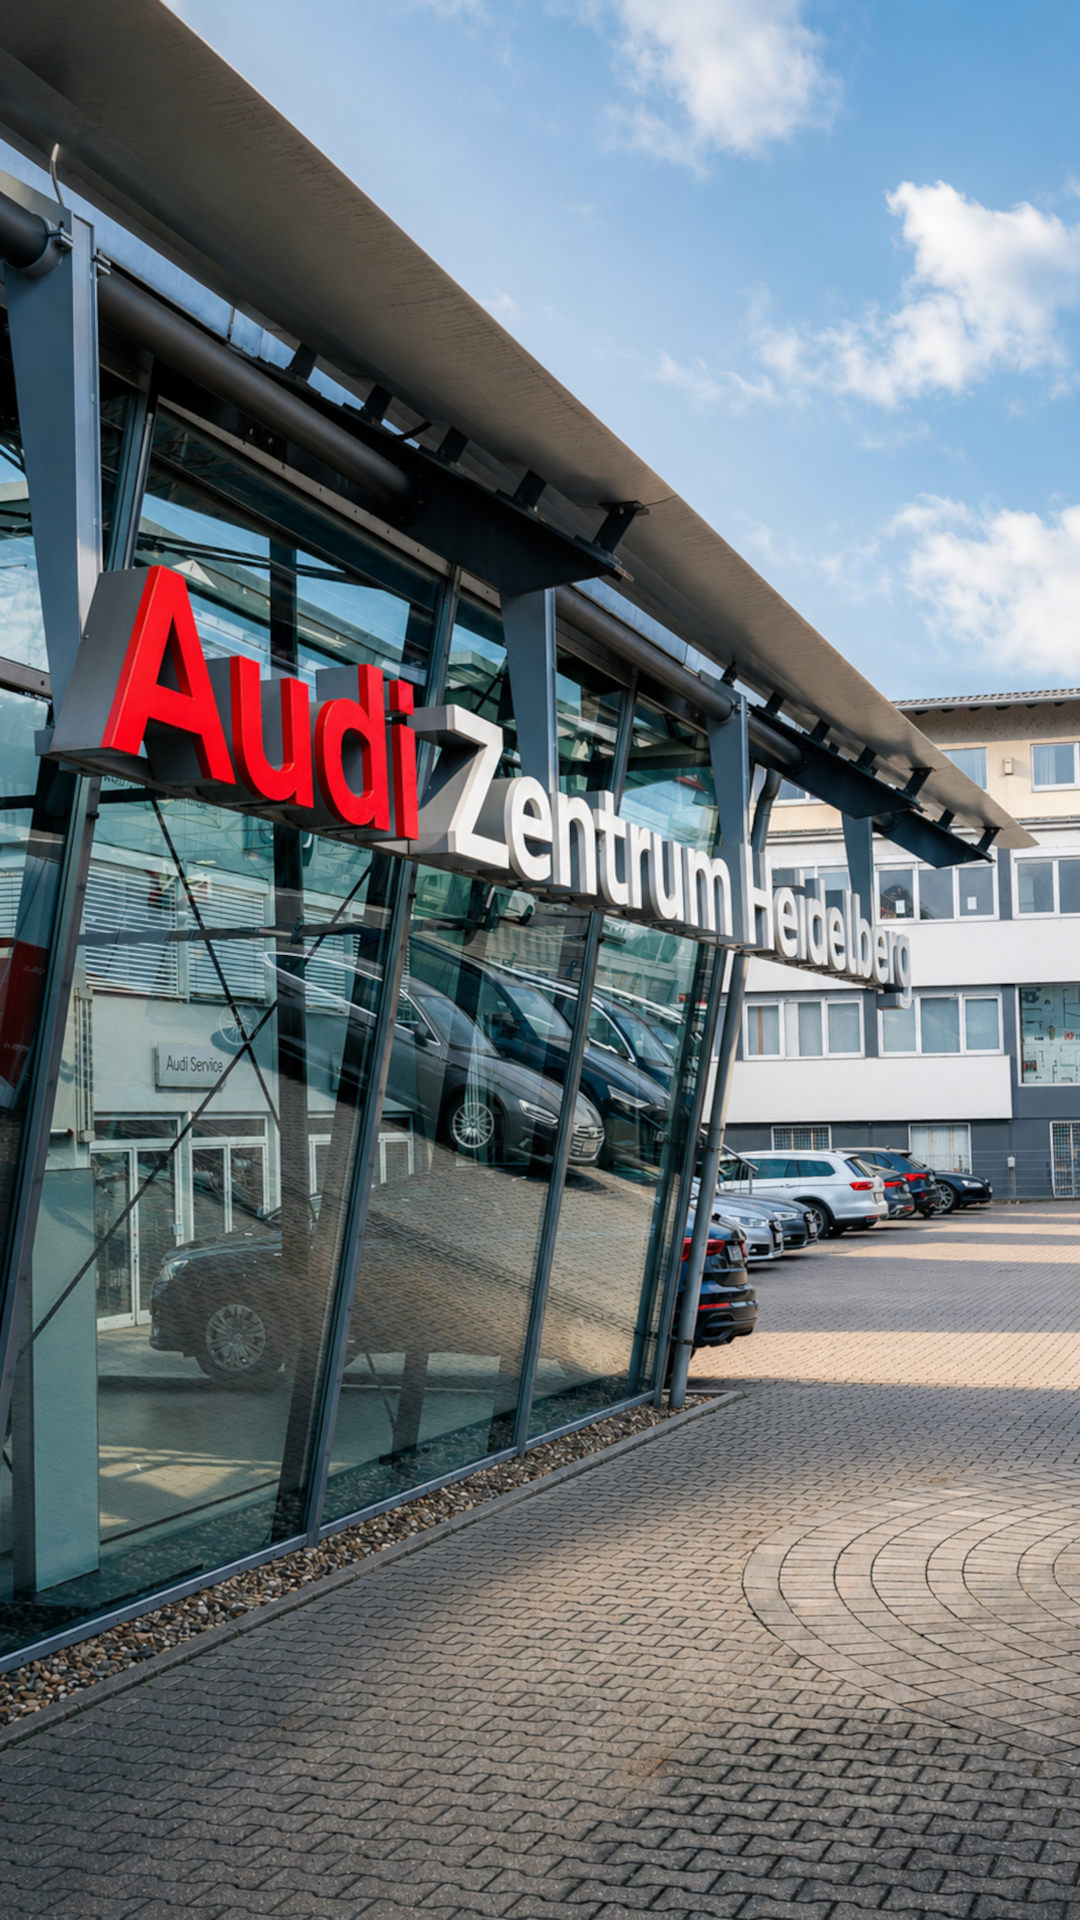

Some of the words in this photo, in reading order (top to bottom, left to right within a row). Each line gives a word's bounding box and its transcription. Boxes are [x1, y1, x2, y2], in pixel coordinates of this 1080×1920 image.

[100, 564, 419, 841] Audi
[447, 704, 734, 937] Zentrum
[743, 843, 912, 1010] Heidelberg
[166, 1055, 189, 1072] Audi
[190, 1056, 224, 1073] Service
